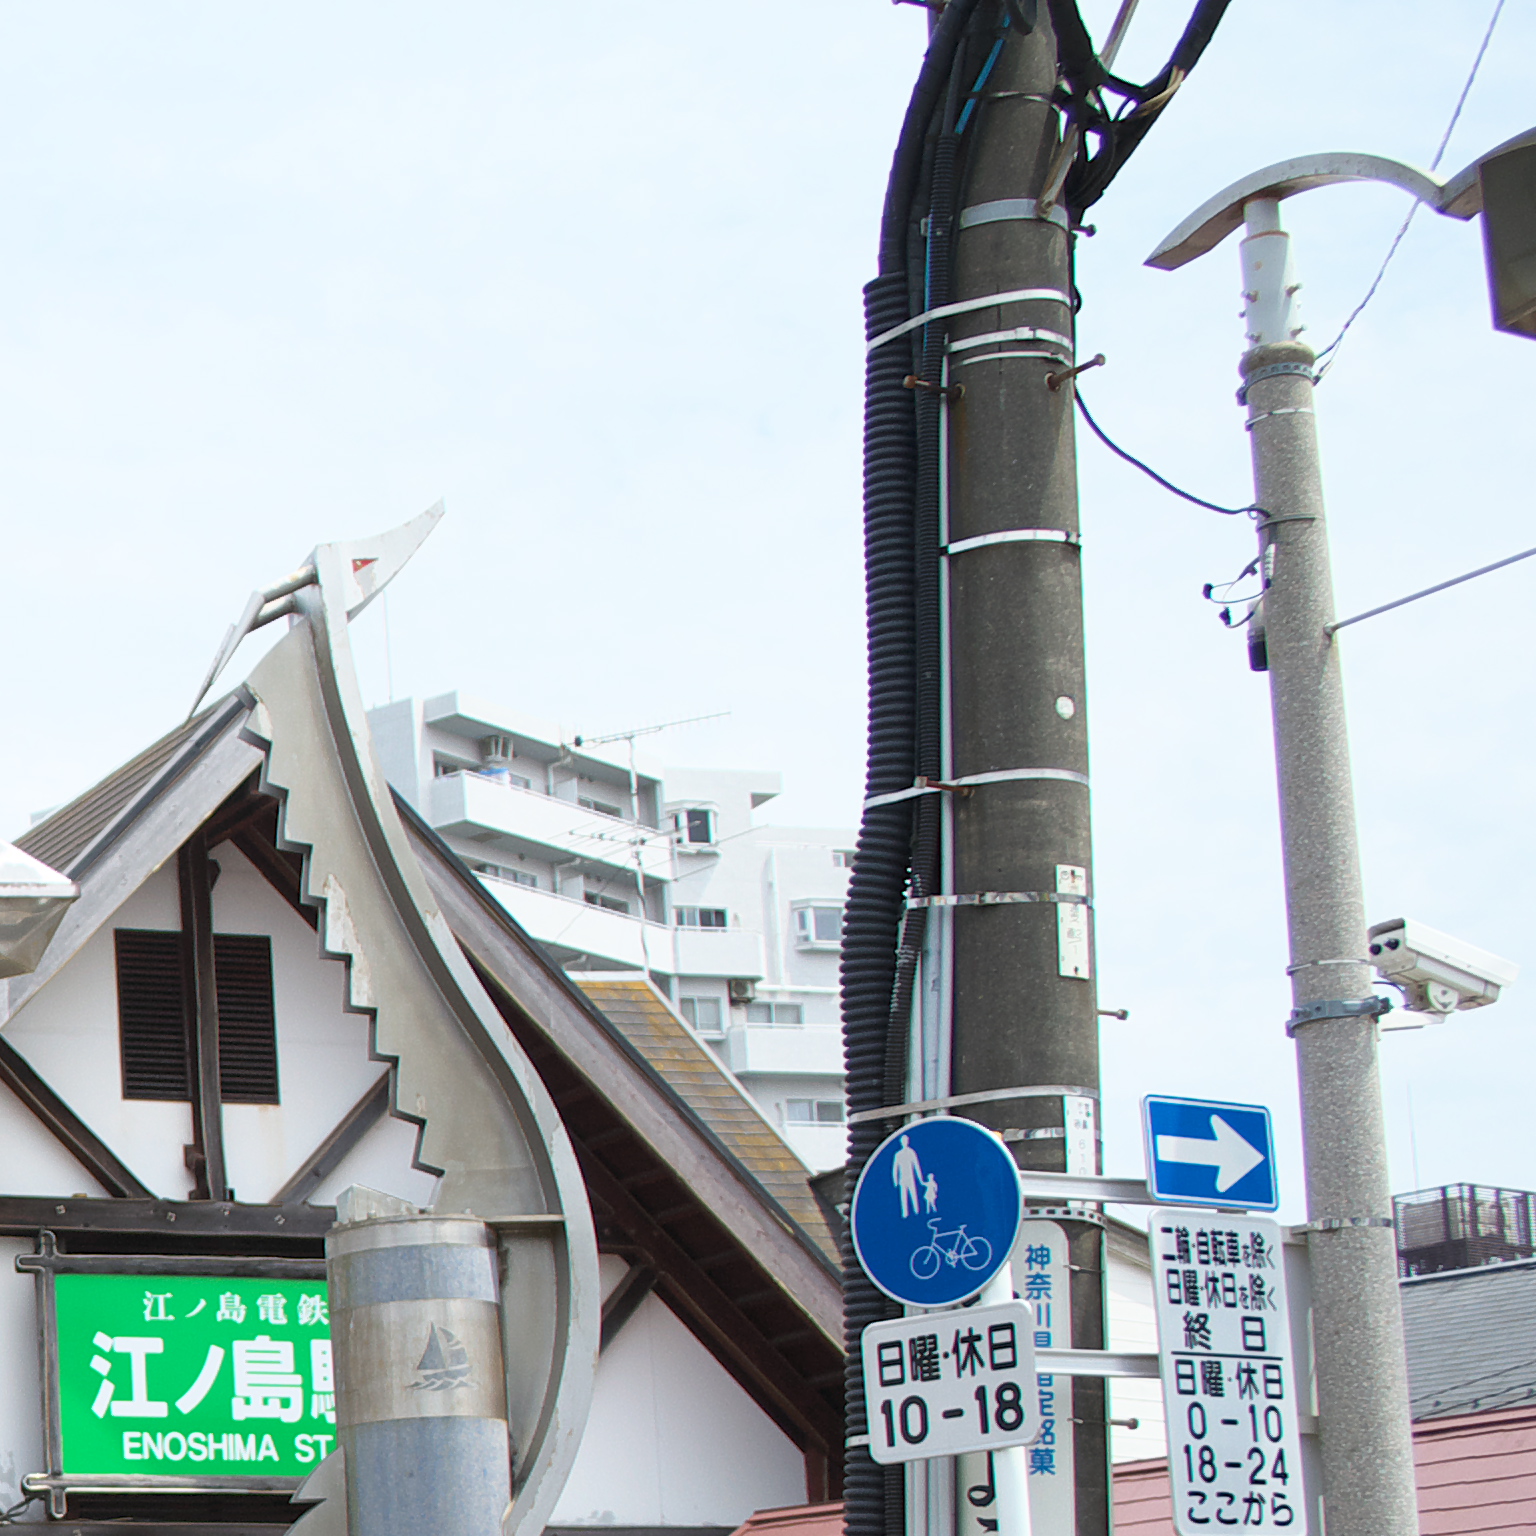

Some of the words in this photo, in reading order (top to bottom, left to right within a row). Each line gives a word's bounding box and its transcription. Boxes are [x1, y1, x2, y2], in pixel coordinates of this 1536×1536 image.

[1166, 1269, 1277, 1311] 日曜・休日を除く
[877, 1322, 1018, 1388] 日曜・休日
[1174, 1359, 1284, 1400] 日曜・休日
[122, 1431, 280, 1462] ENOSHIMA
[1186, 1491, 1295, 1527] ここから
